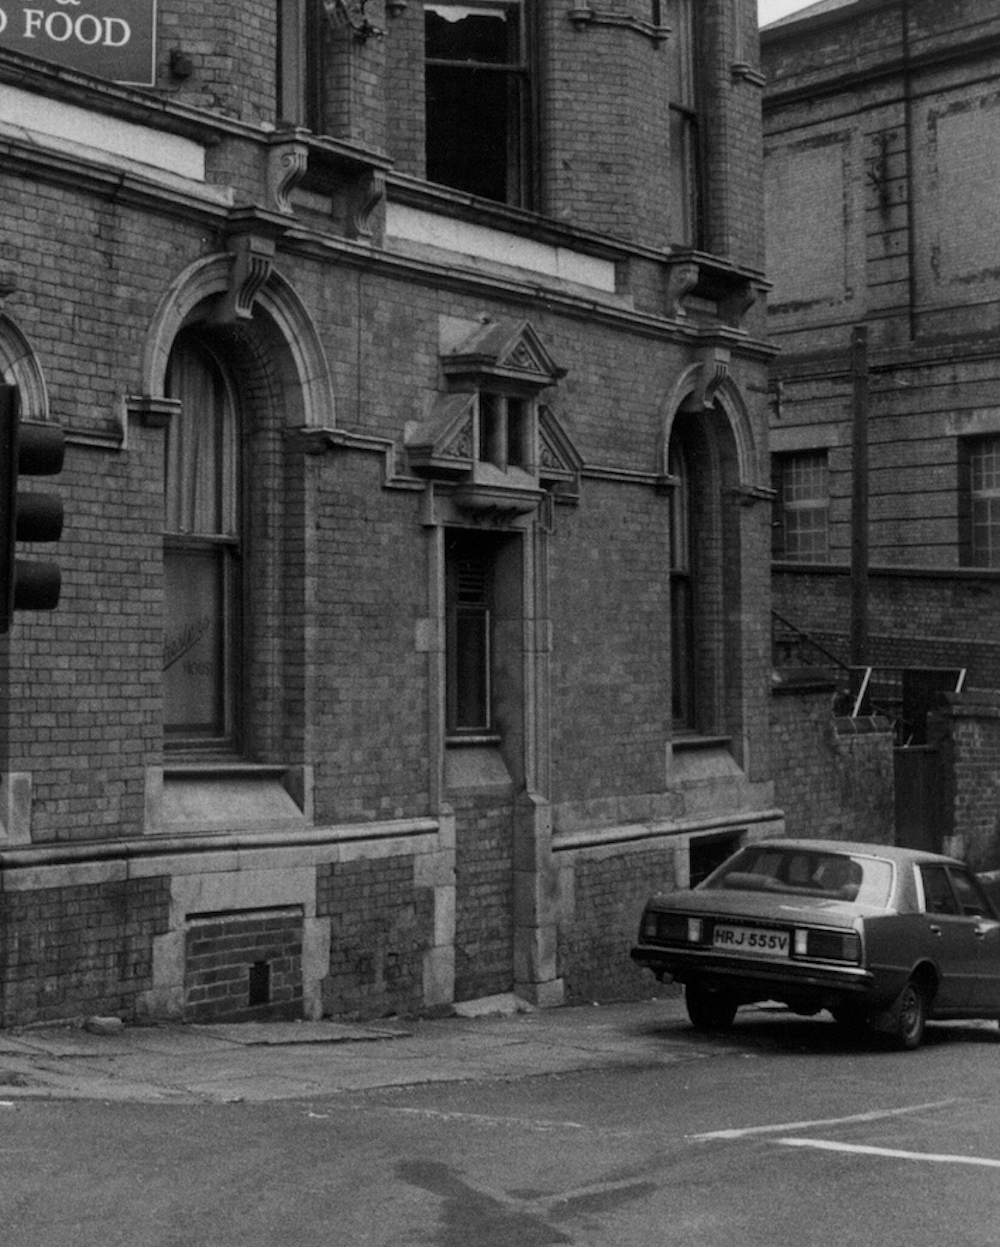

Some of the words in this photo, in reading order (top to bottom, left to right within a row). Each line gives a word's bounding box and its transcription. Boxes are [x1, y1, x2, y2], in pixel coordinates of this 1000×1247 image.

[23, 8, 131, 48] FOOD
[715, 929, 745, 945] HRJ
[748, 933, 787, 950] 555V
